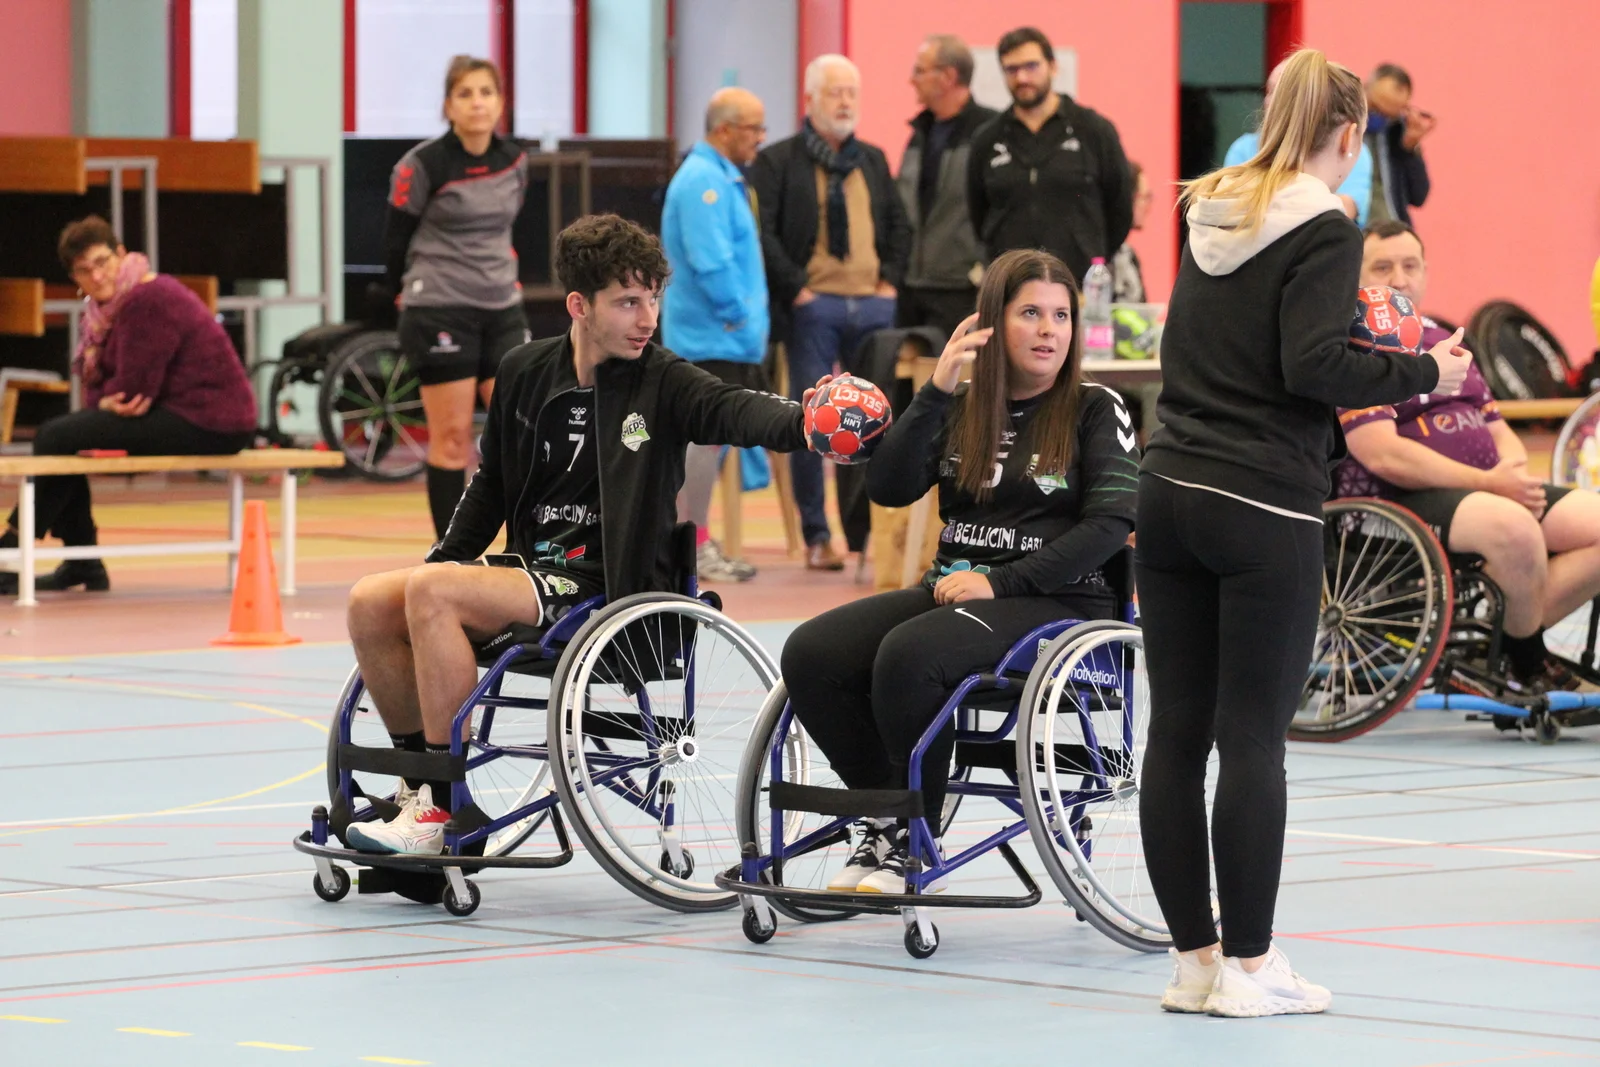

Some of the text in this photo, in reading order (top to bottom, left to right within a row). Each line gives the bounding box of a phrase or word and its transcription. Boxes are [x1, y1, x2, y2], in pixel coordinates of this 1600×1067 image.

[833, 386, 883, 414] SELECT
[843, 417, 861, 429] LNH
[568, 433, 585, 472] 7
[954, 522, 1016, 550] BELLICINI
